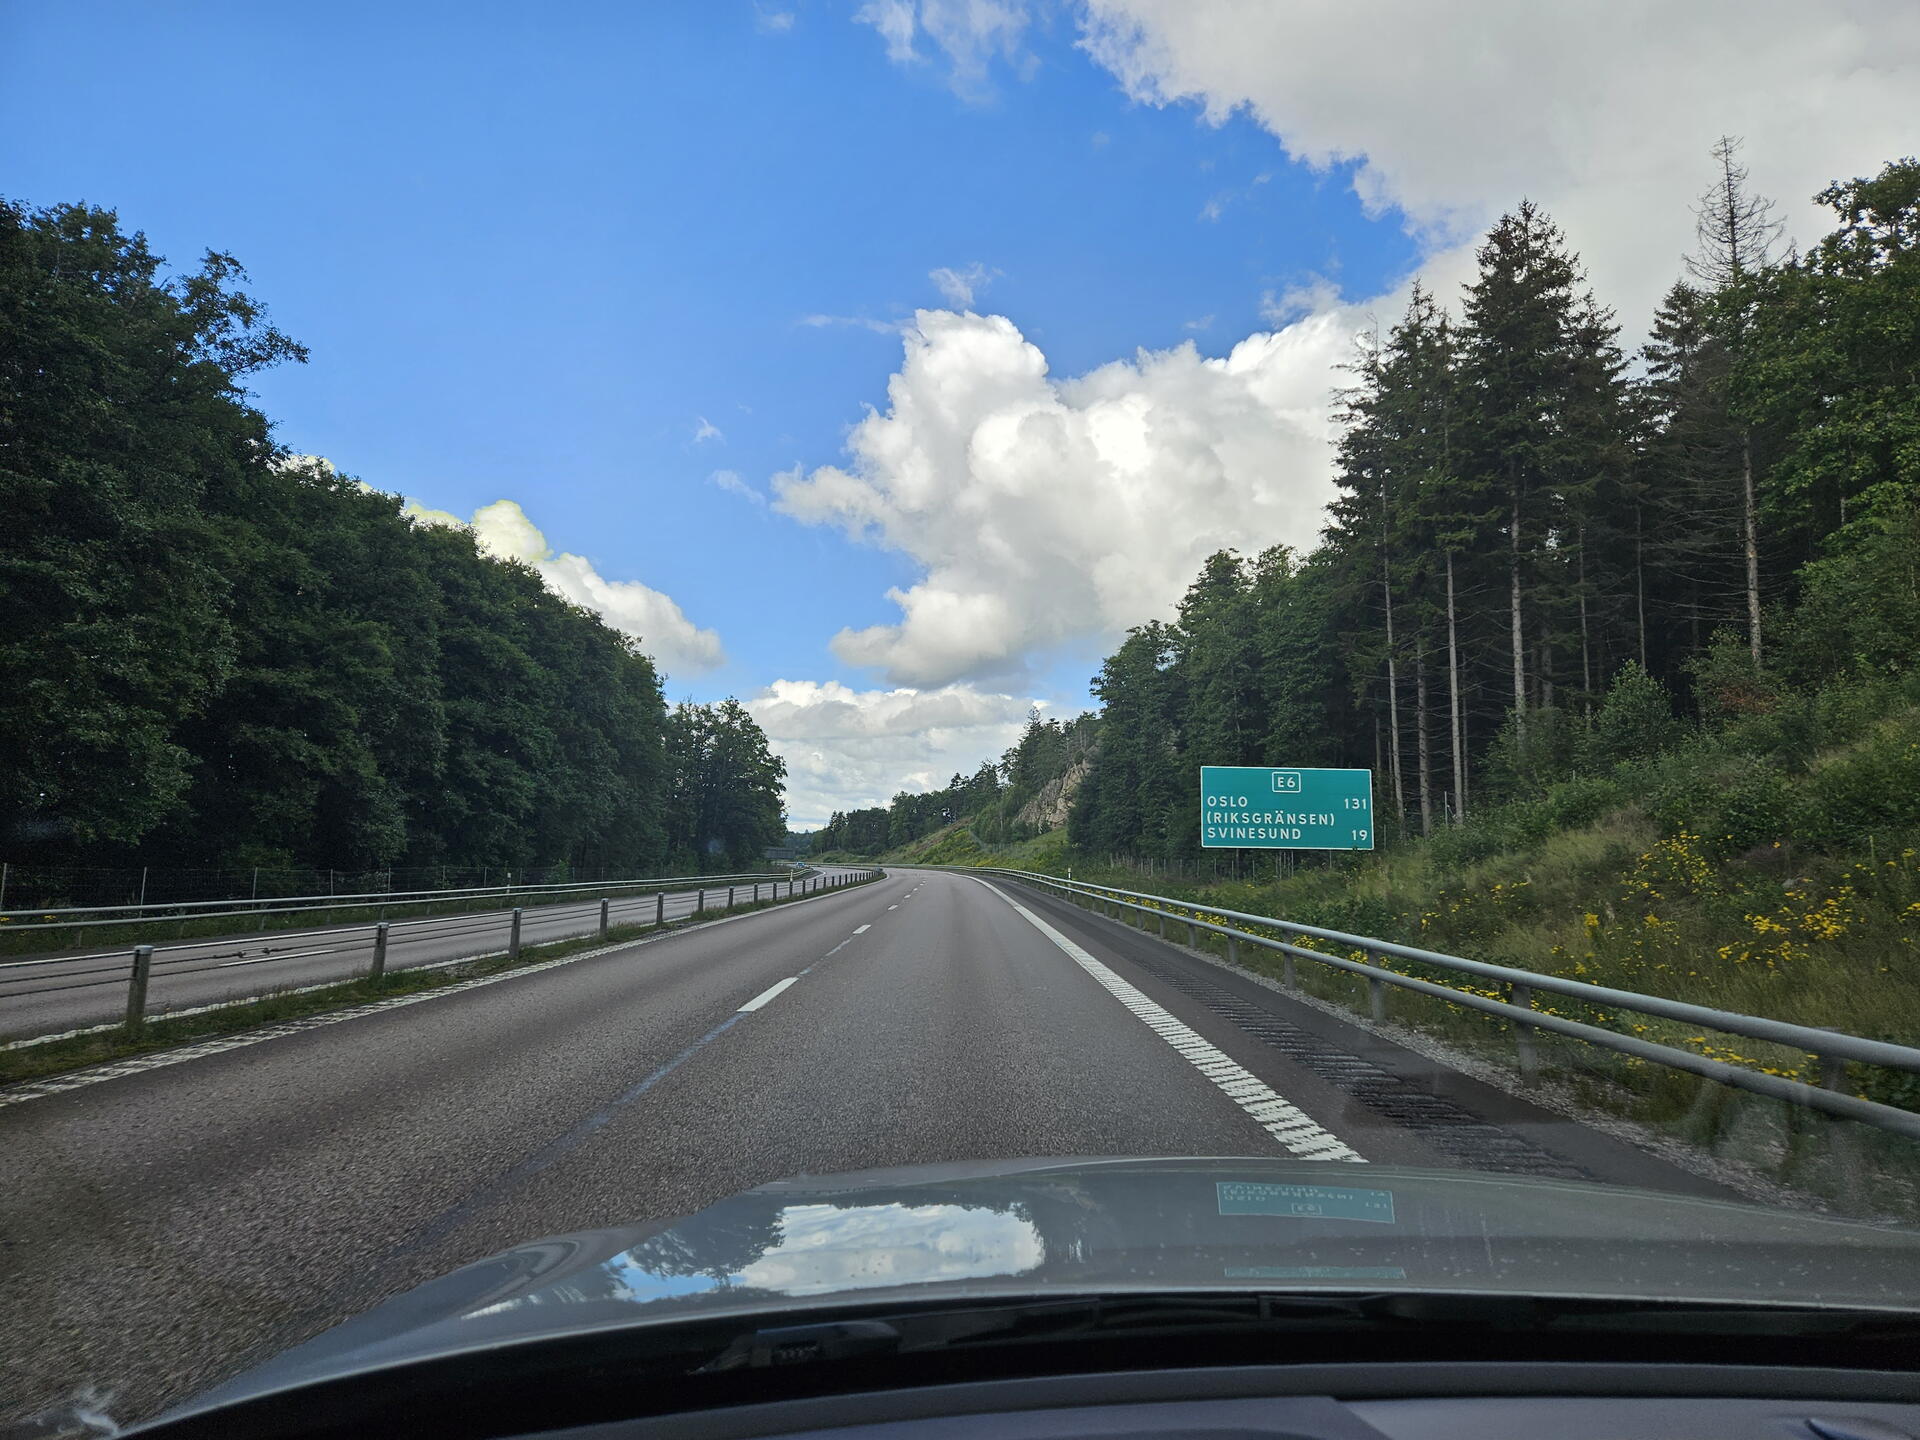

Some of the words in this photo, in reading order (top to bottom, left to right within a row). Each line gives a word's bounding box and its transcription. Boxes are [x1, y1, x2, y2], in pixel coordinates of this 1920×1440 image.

[1277, 777, 1296, 788] E6
[1207, 796, 1248, 807] OSLO
[1344, 798, 1367, 810] 131
[1206, 811, 1335, 826] (RIKSGRÄNSEN)
[1207, 827, 1301, 840] SVINESUND
[1351, 829, 1368, 841] 19
